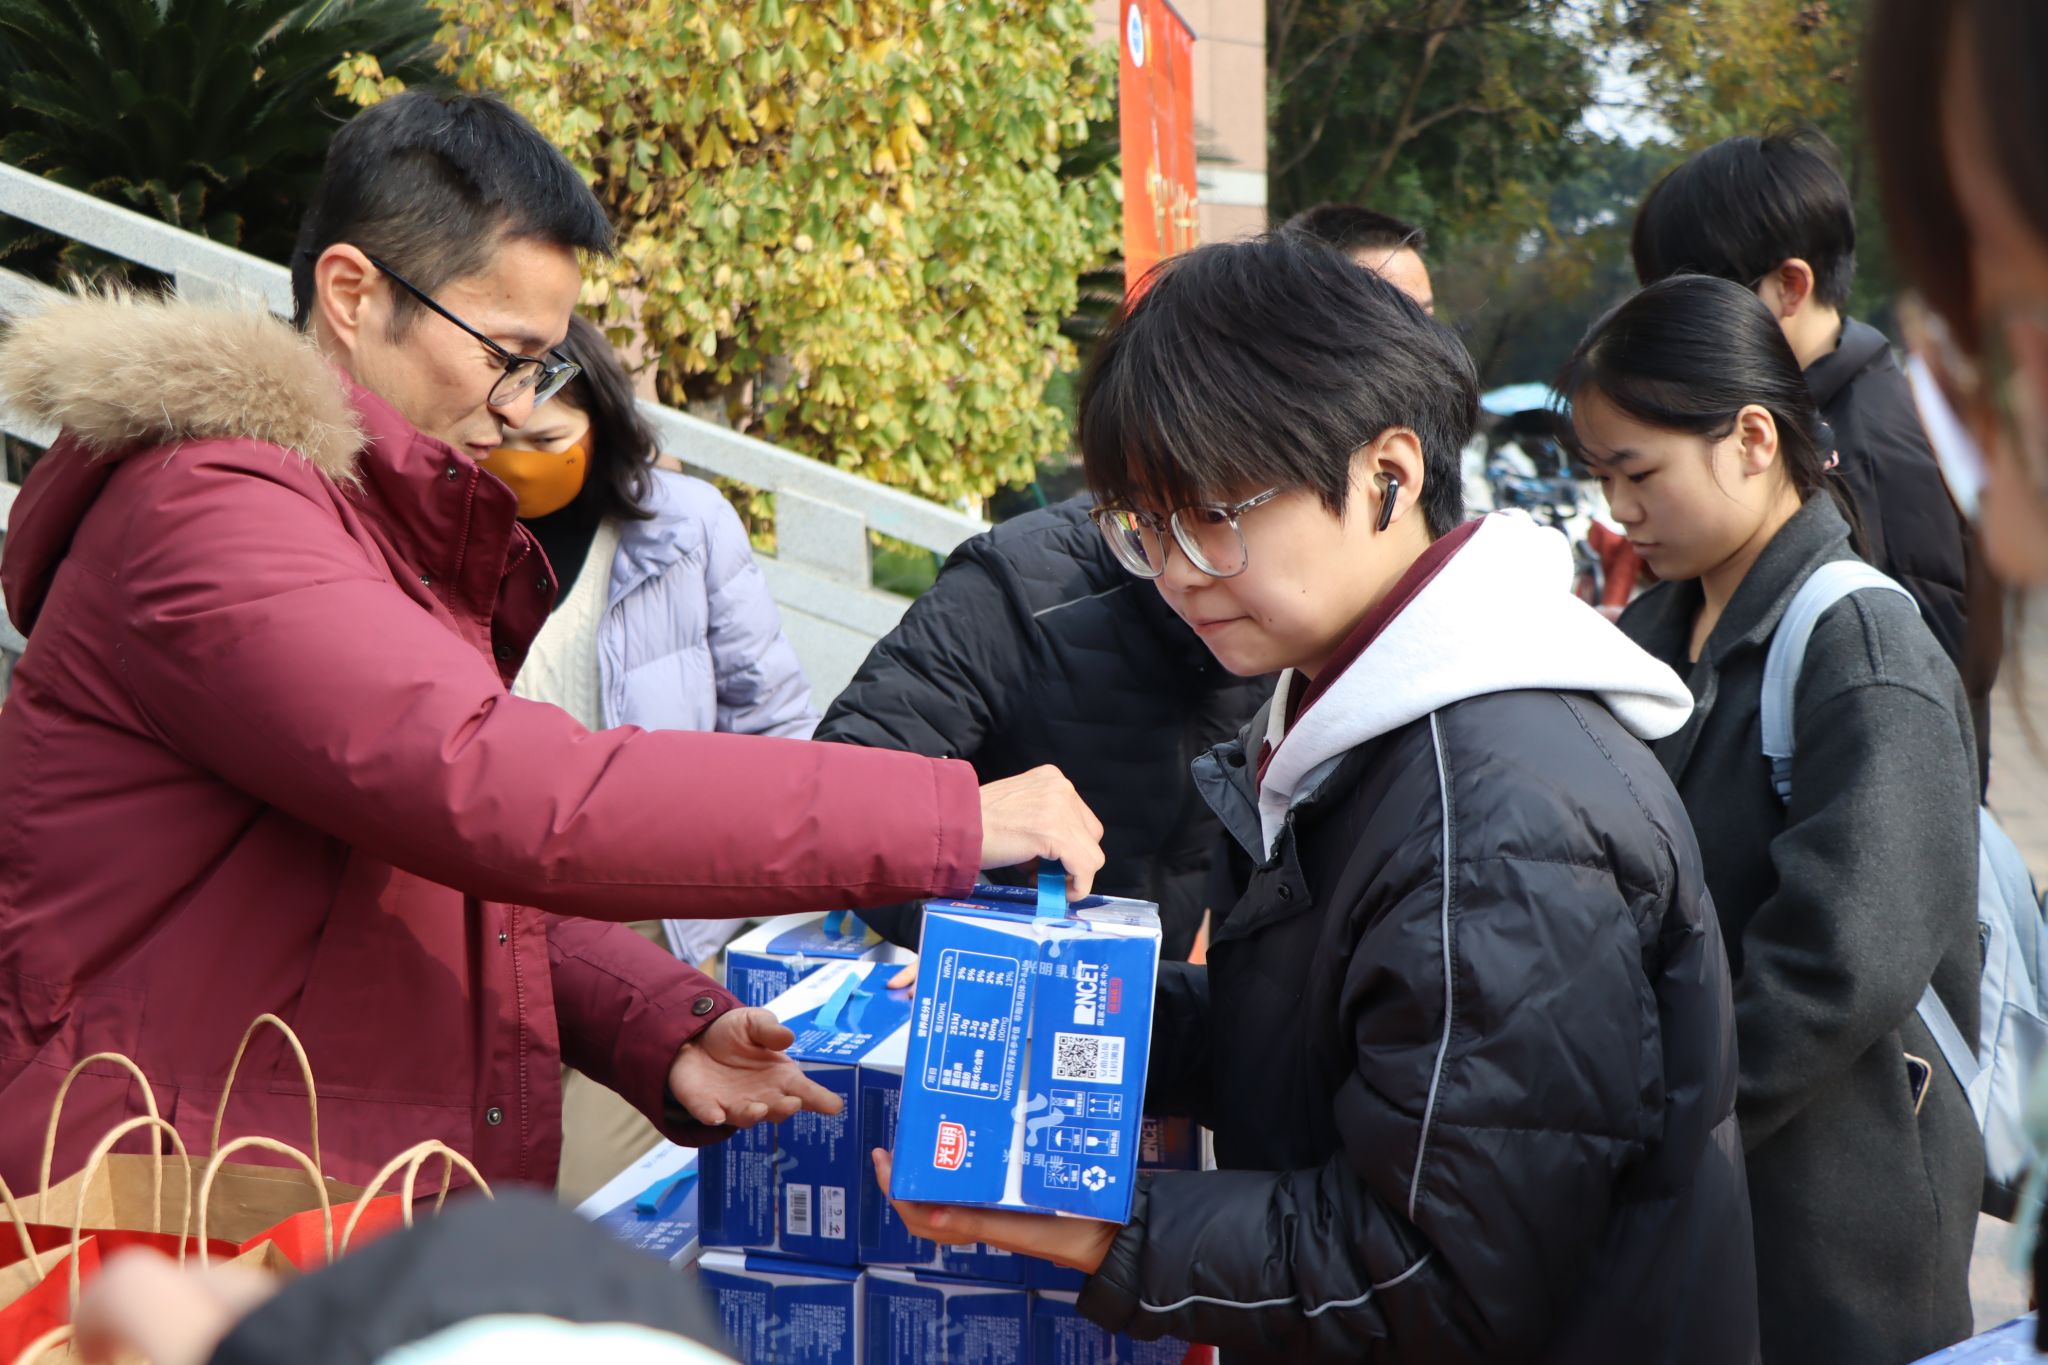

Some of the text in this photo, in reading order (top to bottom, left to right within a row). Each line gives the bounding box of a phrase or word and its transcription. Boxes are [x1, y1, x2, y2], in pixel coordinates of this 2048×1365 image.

[919, 997, 932, 1038] 营养成分表
[928, 1064, 936, 1083] 项目
[944, 955, 953, 979] NRV%
[942, 1069, 951, 1086] 能量
[958, 968, 967, 980] 3%
[951, 968, 976, 1086] 蛋白质 3.0g 5%
[961, 970, 986, 1089] 脂肪 3.2g 5%
[970, 971, 995, 1089] 碳水化合物 4.8g 2%
[980, 973, 1004, 1092] 钠 60mg 3%
[998, 1017, 1008, 1042] 100mg
[1005, 971, 1014, 986] 13%
[1096, 963, 1109, 1027] 国家企业技术中心
[1002, 1026, 1020, 1101] NRV表示营养素参考值
[936, 1128, 957, 1166] 光明
